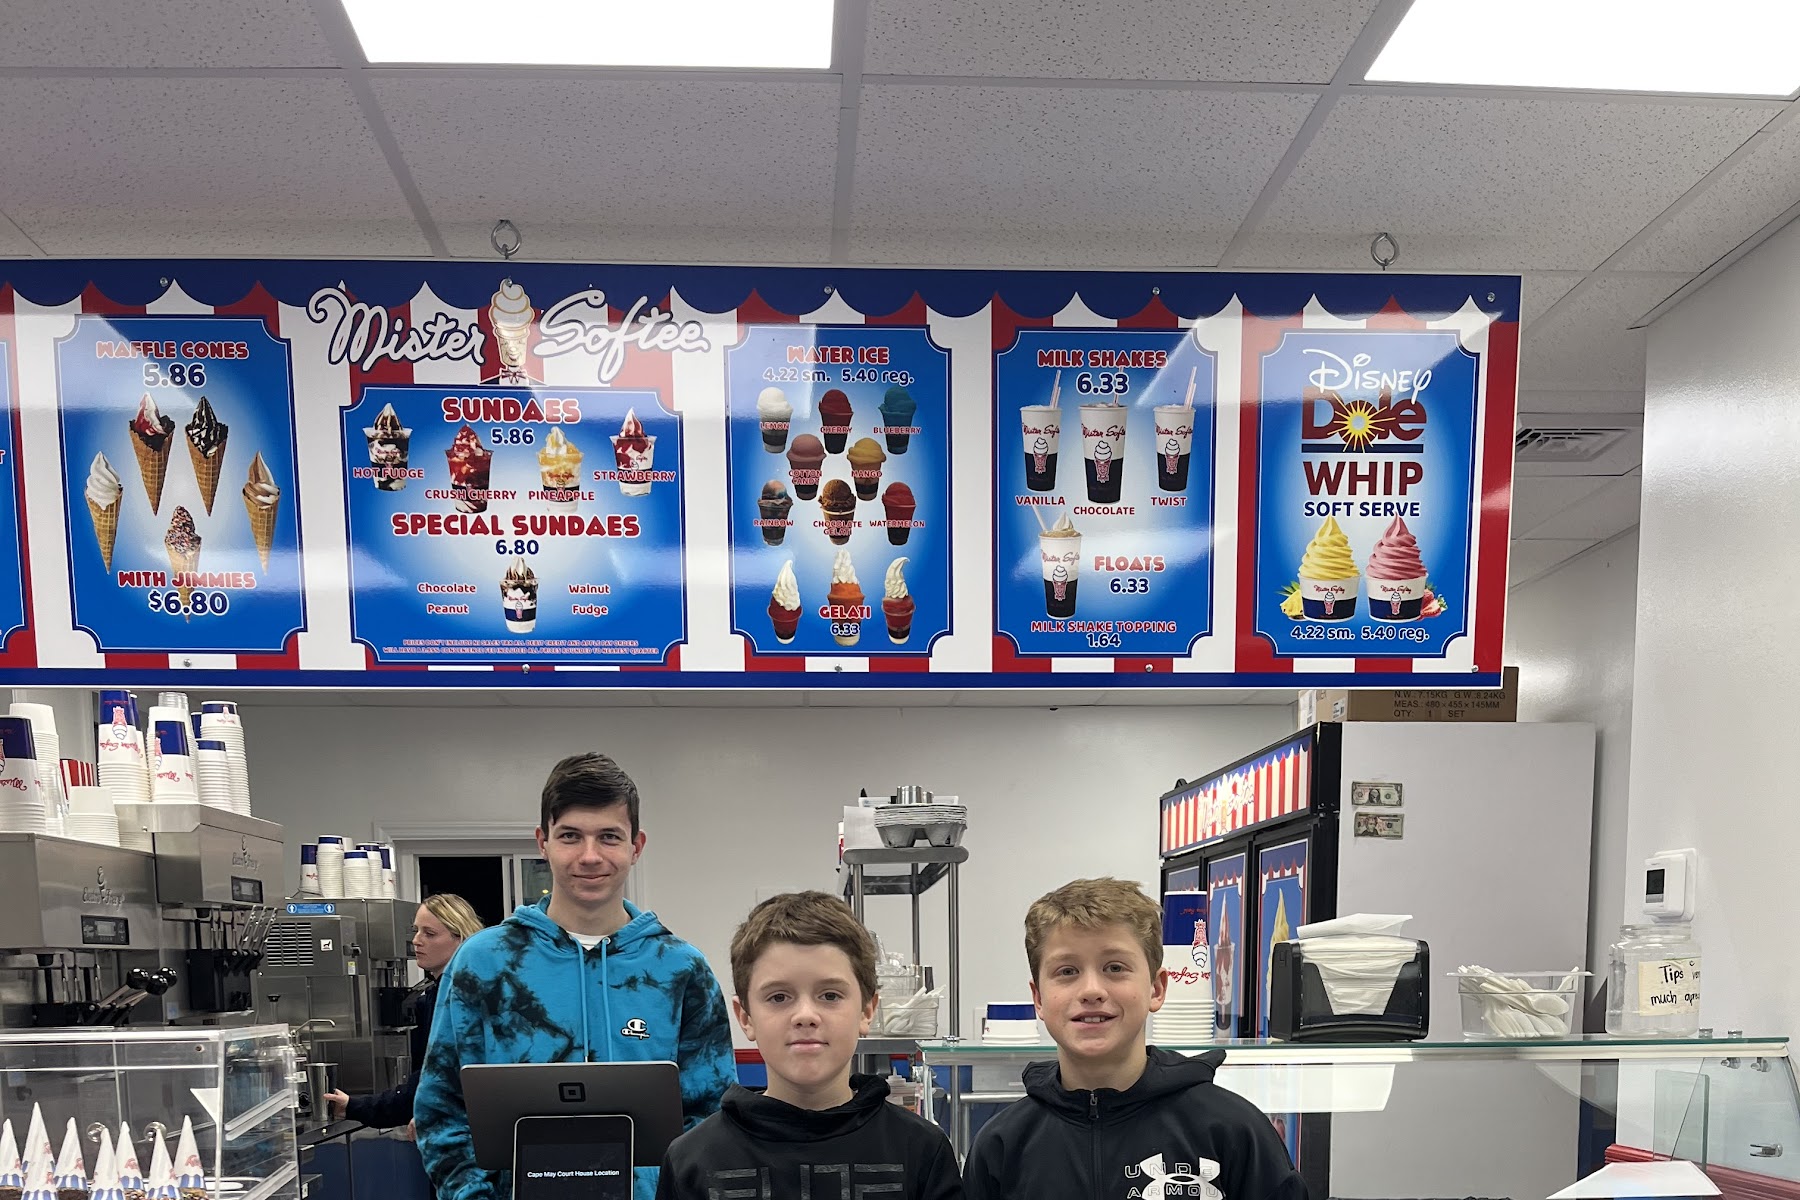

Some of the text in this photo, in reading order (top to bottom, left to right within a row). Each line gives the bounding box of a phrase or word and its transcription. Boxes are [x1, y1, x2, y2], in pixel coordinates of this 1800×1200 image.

[308, 287, 711, 383] Mister Softee
[96, 341, 249, 359] WAFFLE CONES
[787, 346, 889, 365] WATER ICE
[1037, 349, 1168, 368] MILK SHAKES
[143, 362, 206, 388] 5.86
[763, 367, 914, 386] 4.22 sm. 5.40 reg.
[1076, 372, 1129, 395] 6.33
[442, 398, 582, 424] SUNDAES
[1301, 386, 1427, 447] Dole
[760, 421, 790, 430] LEMON
[873, 427, 922, 435] BLUEBERRY
[491, 428, 534, 446] 5.86
[353, 467, 424, 479] HOT FUDGE
[593, 470, 676, 482] STRAWBERRY
[1303, 461, 1424, 496] WHIP
[425, 488, 517, 501] CRUSH CHERRY
[528, 490, 595, 502] PINEAPPLE
[1016, 496, 1066, 506] VANILLA
[1150, 496, 1186, 506] TWIST
[1073, 505, 1135, 515] CHOCOLATE
[1304, 501, 1420, 517] SOFT SERVE
[391, 513, 641, 537] SPECIAL SUNDAES
[753, 519, 794, 527] RAINBOW
[869, 520, 925, 528] WATERMELON
[495, 539, 539, 556] 6.80
[1094, 556, 1165, 572] FLOATS
[118, 571, 256, 588] WITH JIMMIES
[1109, 578, 1150, 594] 6.33
[418, 583, 476, 594] Chocolate
[568, 583, 610, 594] Walnut
[149, 590, 229, 616] $6.80
[427, 604, 469, 614] Peanut
[572, 604, 608, 616] Fudge
[819, 605, 871, 619] GELATI
[830, 622, 860, 635] 6.33
[1031, 621, 1177, 633] MILK SHAKE TOPPING
[1291, 626, 1429, 642] 4.22 sm. 5.40 reg.
[1086, 633, 1120, 647] 1.64
[1448, 710, 1465, 718] SET
[1659, 965, 1684, 984] Tips
[1651, 991, 1677, 1006] much
